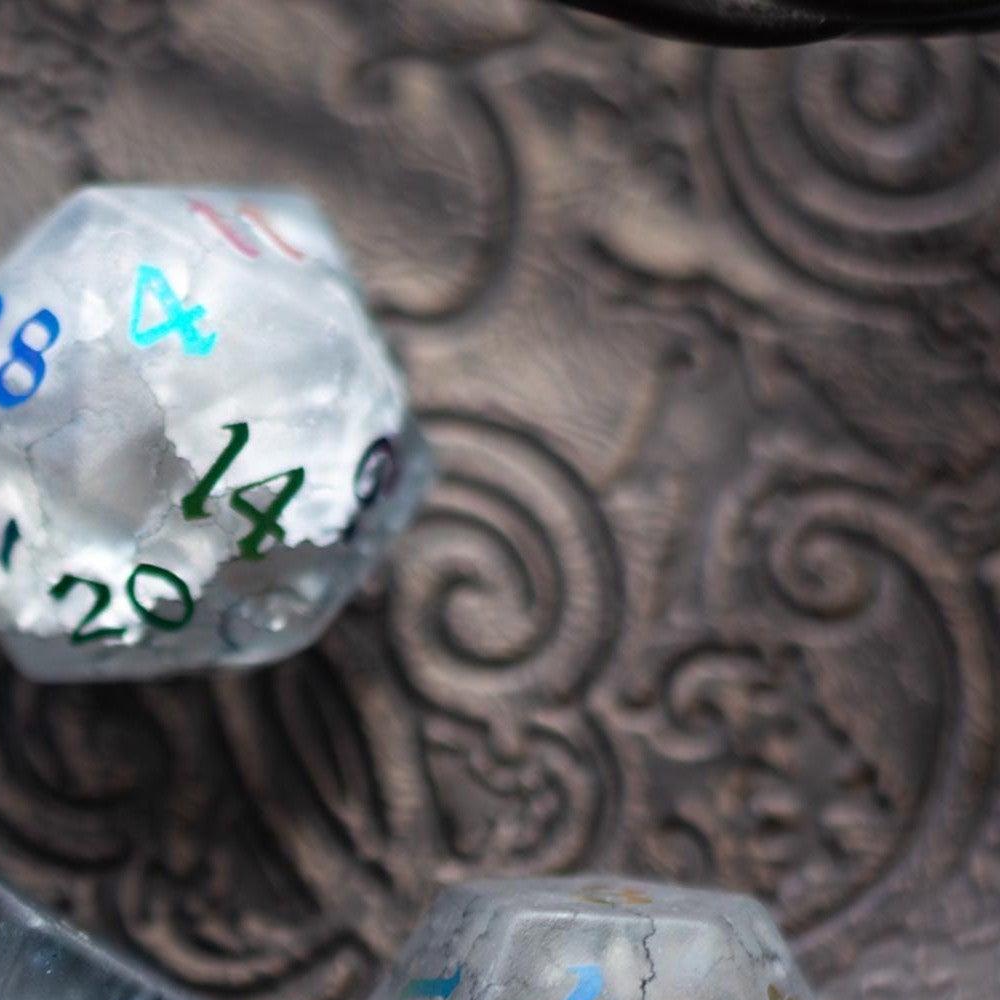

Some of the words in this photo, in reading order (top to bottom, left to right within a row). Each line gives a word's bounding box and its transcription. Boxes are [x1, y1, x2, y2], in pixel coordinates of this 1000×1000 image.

[129, 265, 217, 356] 4
[182, 422, 304, 562] 14
[51, 563, 194, 645] 20
